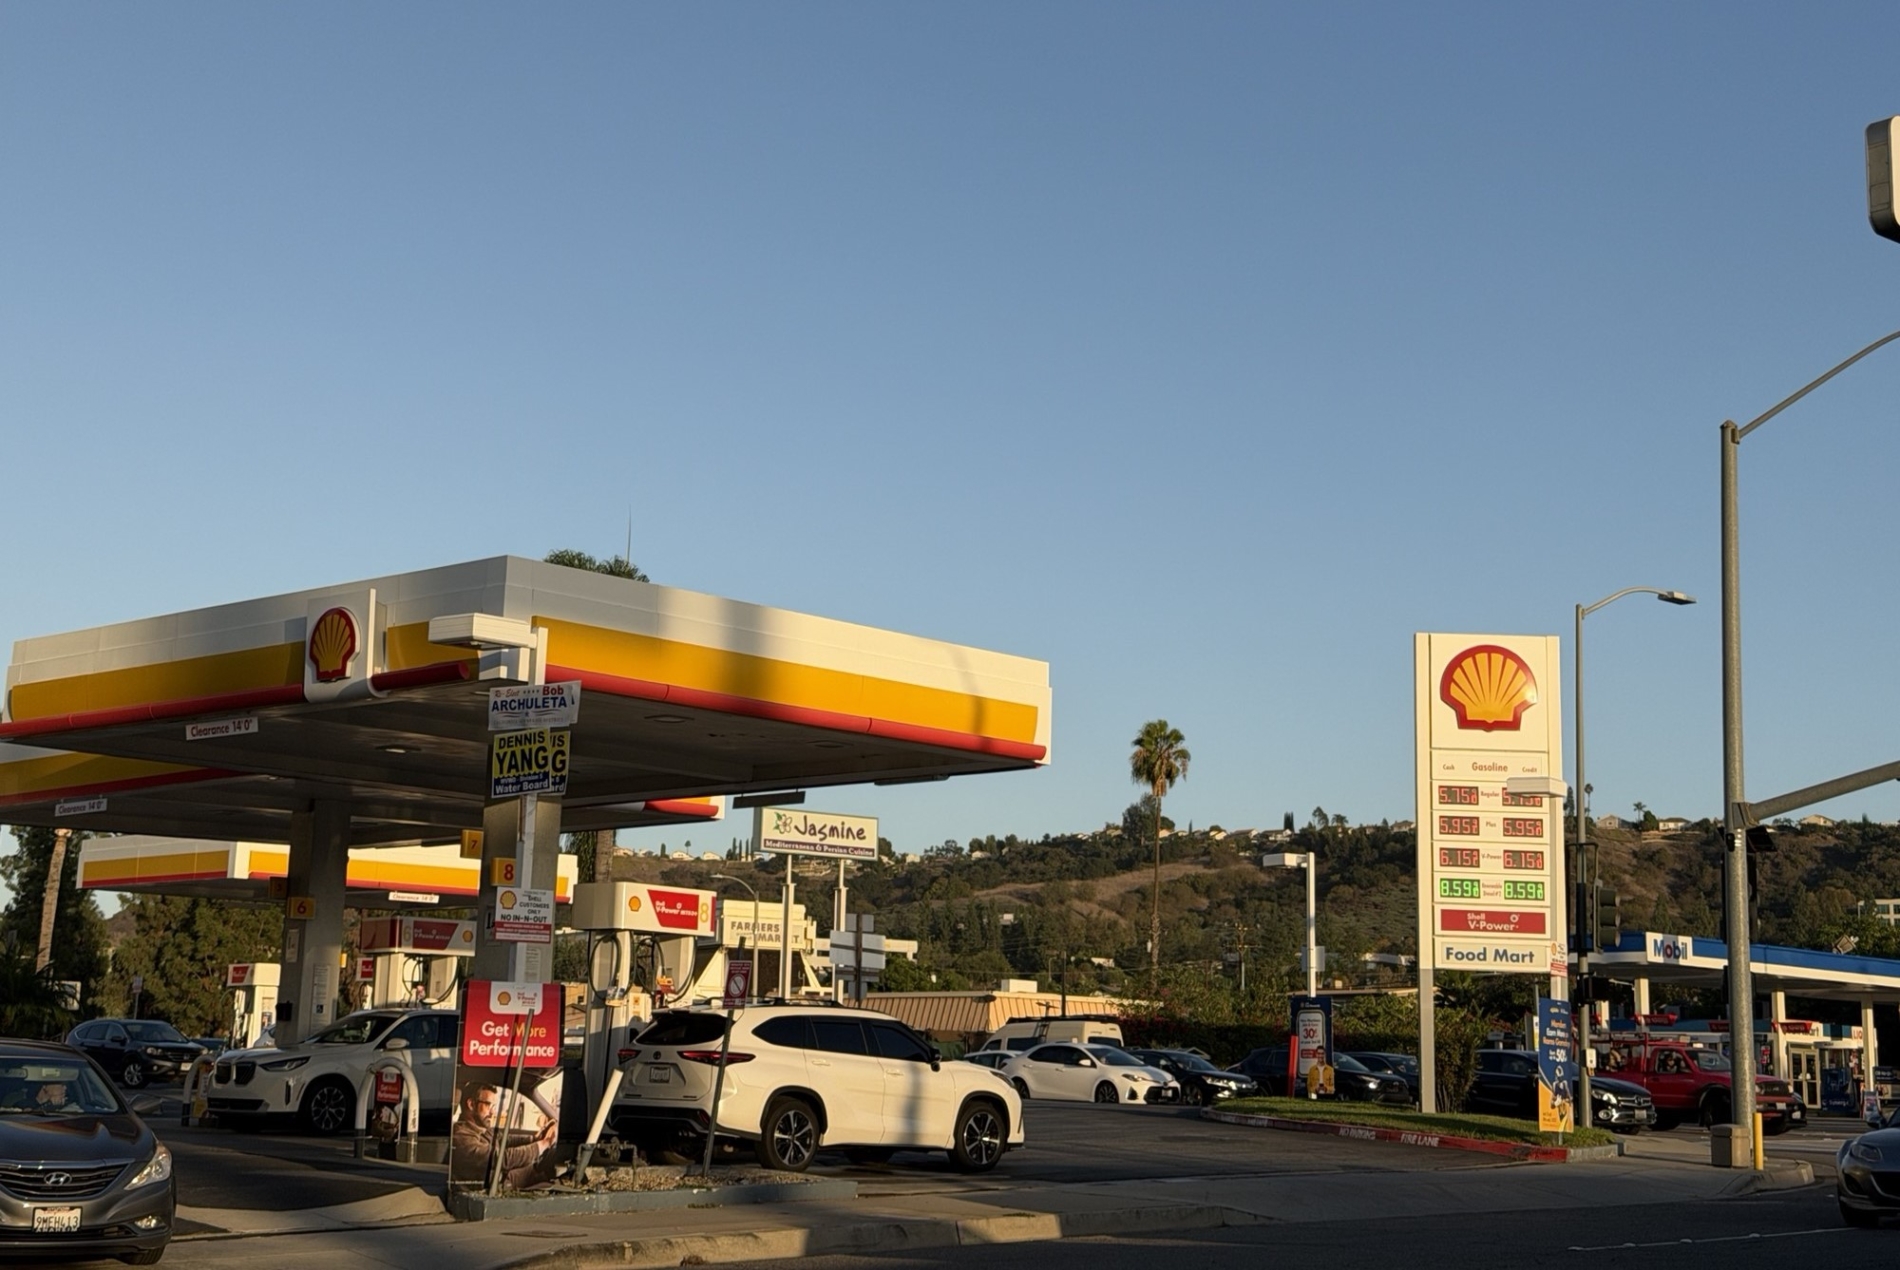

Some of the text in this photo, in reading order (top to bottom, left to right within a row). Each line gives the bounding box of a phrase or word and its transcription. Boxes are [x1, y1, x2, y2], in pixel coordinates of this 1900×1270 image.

[542, 685, 564, 696] Bob
[491, 696, 567, 712] ARCHULETA
[190, 725, 230, 738] Clearance
[498, 731, 545, 750] DENNIS
[495, 745, 549, 775] YANG
[1471, 761, 1508, 772] Gasoline
[495, 784, 521, 794] Water
[522, 779, 549, 791] Board
[794, 815, 866, 842] Jasmine
[471, 840, 478, 850] 7
[765, 840, 873, 856] Mediterranean & Persian Cuisine
[503, 863, 514, 881] 8
[297, 901, 307, 914] 6
[512, 914, 548, 923] IN-N-OUT
[1467, 912, 1486, 921] Shell
[1468, 920, 1516, 931] V-Power
[1445, 946, 1487, 961] Food
[1493, 948, 1535, 963] Mart
[1653, 938, 1688, 960] Mobil
[481, 1021, 510, 1037] Get
[1400, 1133, 1440, 1147] FIRE LANE
